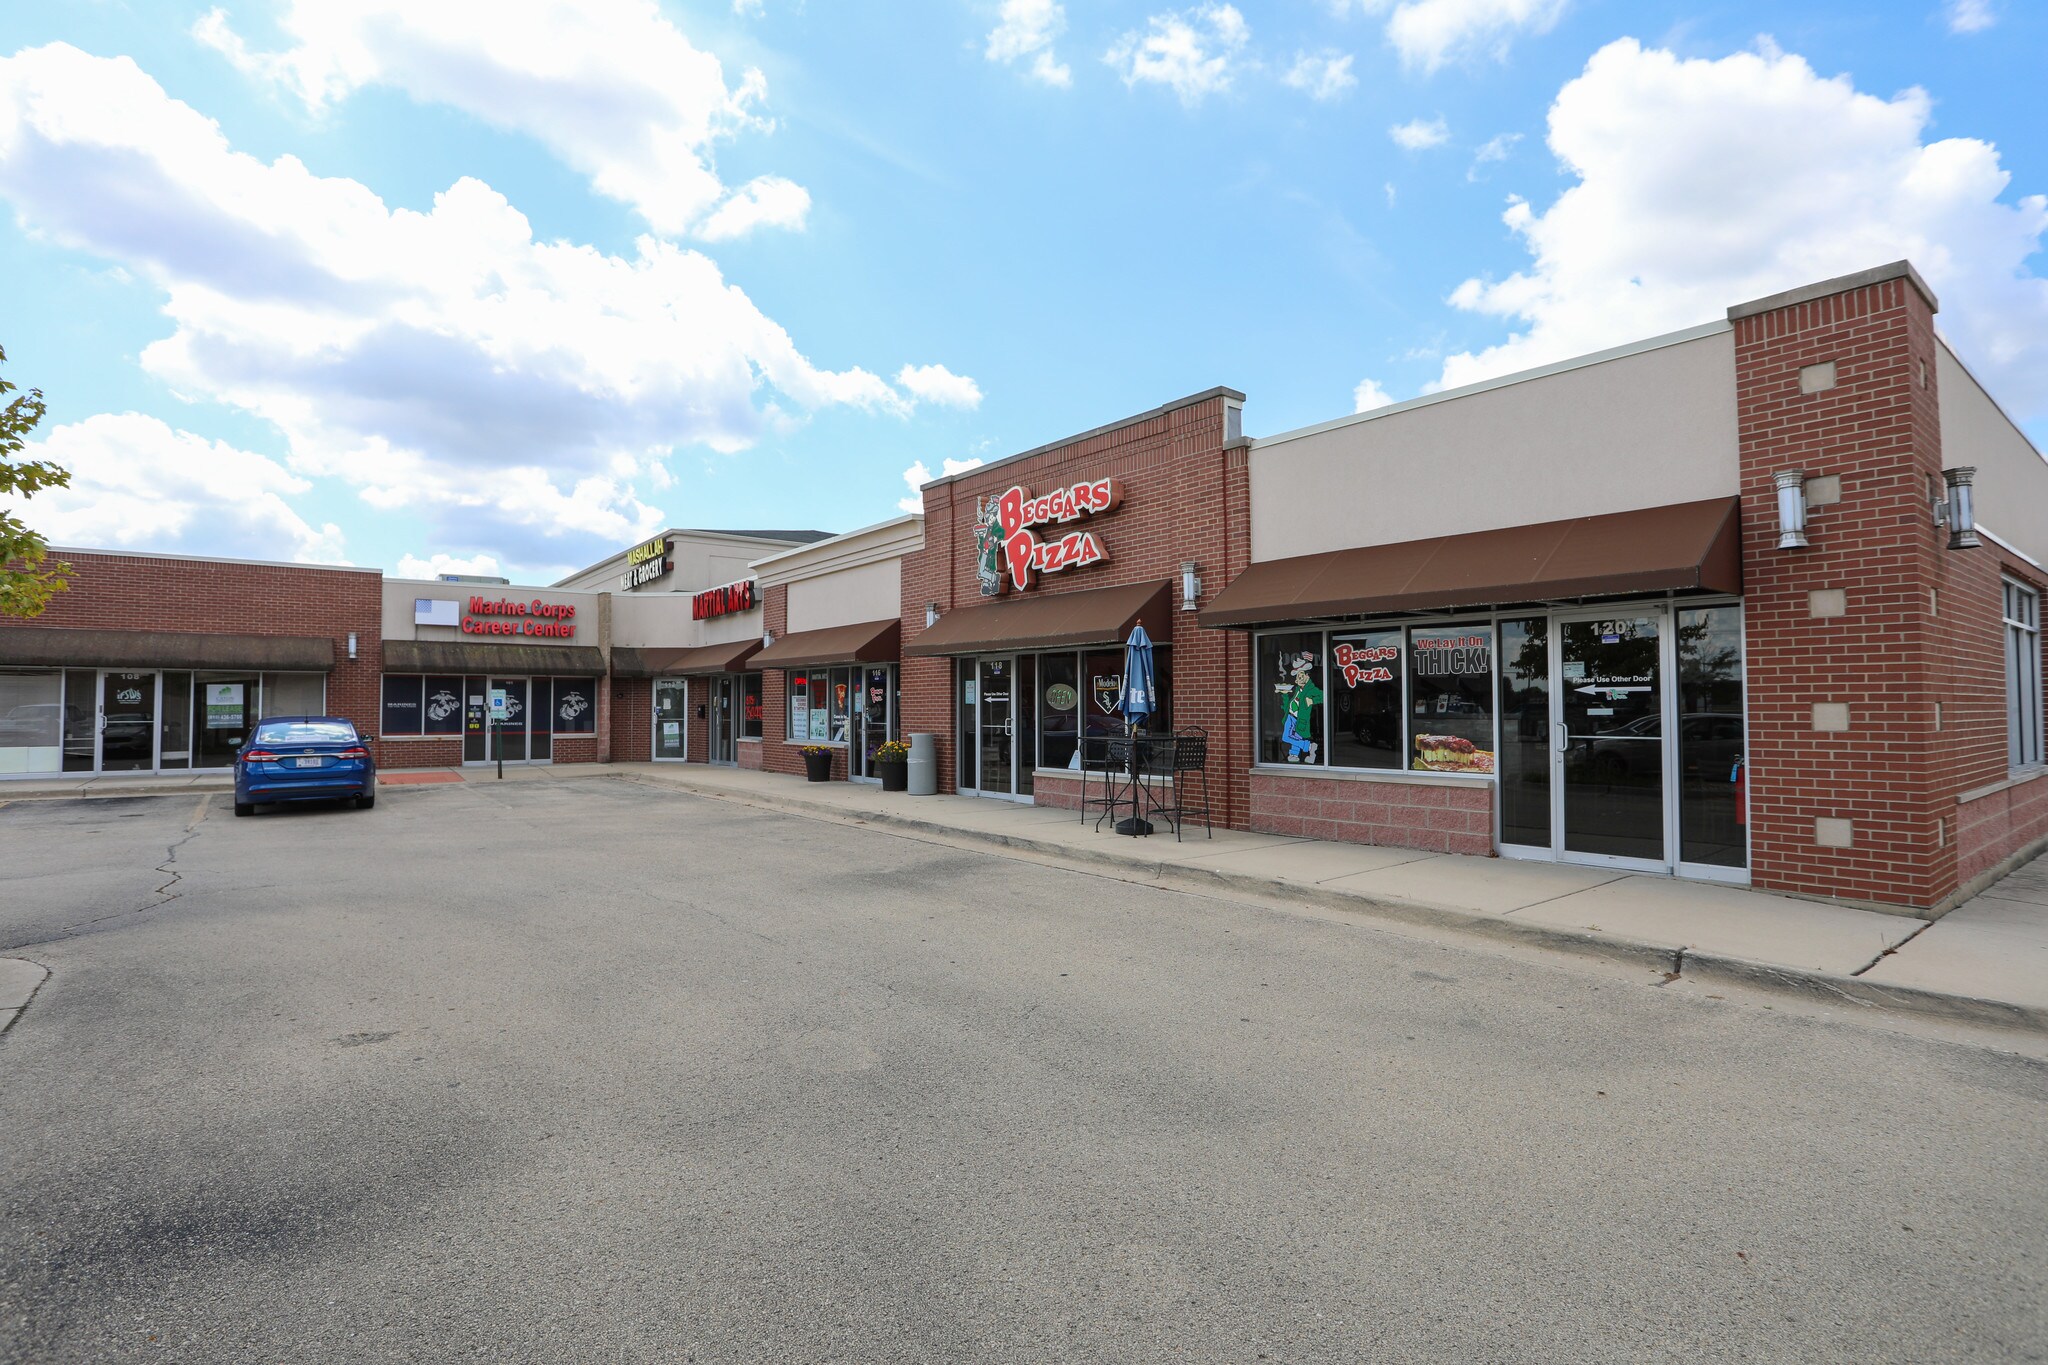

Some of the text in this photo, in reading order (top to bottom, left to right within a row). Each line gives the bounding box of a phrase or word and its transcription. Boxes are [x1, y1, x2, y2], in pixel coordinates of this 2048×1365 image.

[998, 478, 1111, 541] BEGGARS
[627, 538, 664, 567] MASHALLAH
[1005, 529, 1101, 591] PIZZA
[638, 557, 662, 584] GROCERY
[469, 596, 576, 620] Marine Corps
[693, 580, 751, 620] MARTIAL ARTS
[462, 615, 577, 638] Career Center
[1590, 622, 1627, 636] 120
[1417, 639, 1435, 650] We
[1437, 638, 1456, 649] Lay
[1468, 635, 1484, 647] On
[991, 661, 1003, 670] 118
[1334, 644, 1397, 667] BEGGARS
[1414, 647, 1488, 675] THICK!
[1343, 663, 1393, 688] PIZZA
